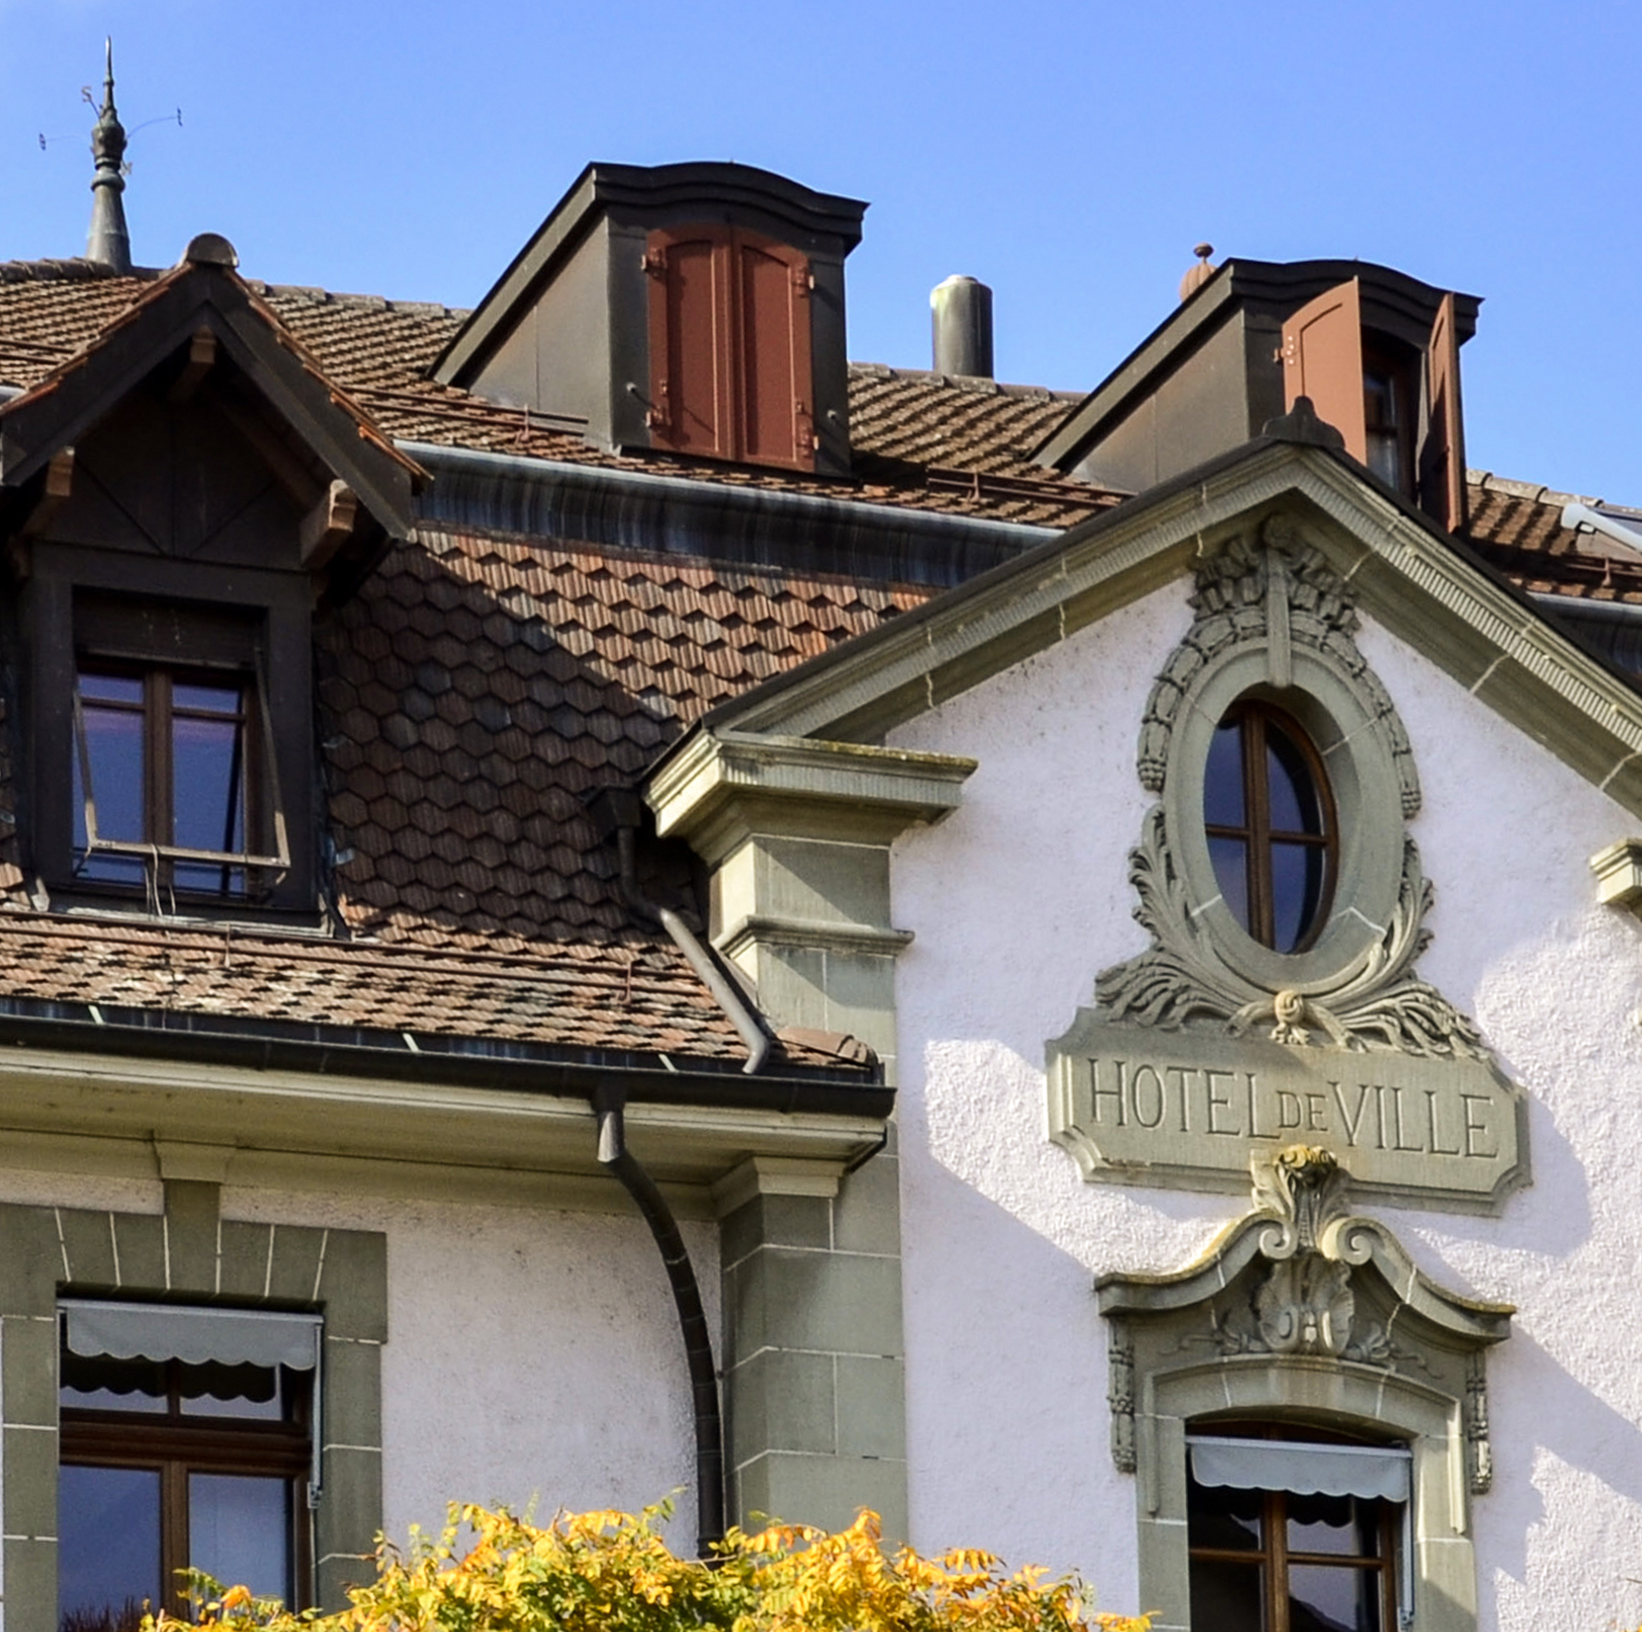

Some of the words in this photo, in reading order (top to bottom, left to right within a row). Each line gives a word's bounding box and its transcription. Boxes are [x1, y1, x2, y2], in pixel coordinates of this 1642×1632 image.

[1087, 1058, 1281, 1139] HOTEL
[1277, 1090, 1329, 1132] DE
[1327, 1081, 1499, 1159] VILLE
